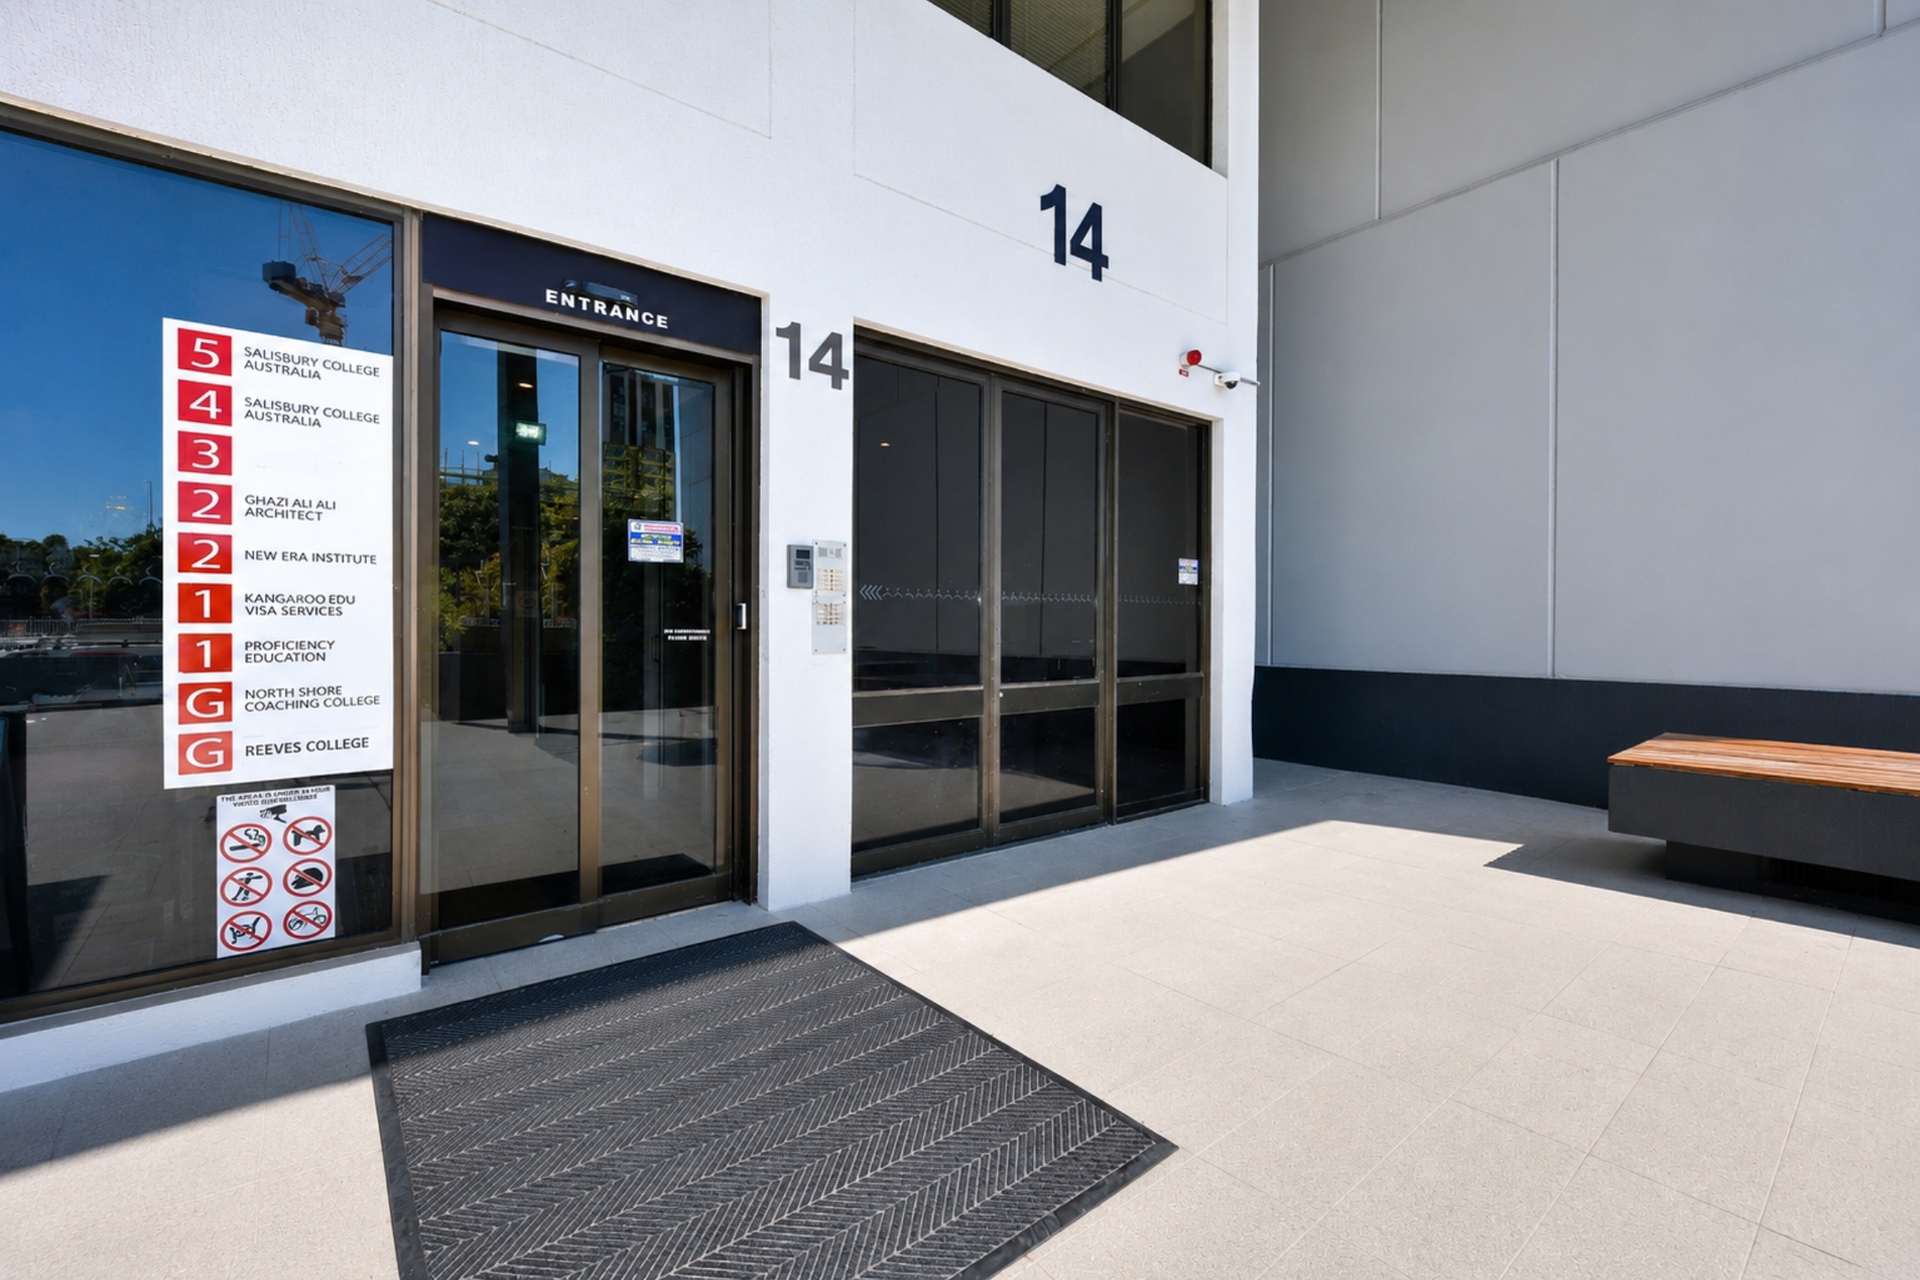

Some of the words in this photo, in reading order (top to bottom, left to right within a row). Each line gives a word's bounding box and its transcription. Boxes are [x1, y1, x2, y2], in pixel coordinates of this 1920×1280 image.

[1041, 184, 1108, 282] 14
[546, 289, 667, 328] ENTRANCE
[191, 337, 220, 369] 5
[245, 347, 318, 366] SALISBURY
[323, 360, 379, 377] COLLEGE
[776, 322, 849, 390] 14
[244, 360, 321, 380] AUSTRALIA
[190, 391, 221, 419] 4
[245, 397, 319, 415] SALISBURY
[323, 408, 379, 424] COLLEGE
[245, 410, 321, 427] AUSTRALIA
[192, 440, 219, 468] 3
[192, 490, 220, 518] 2
[245, 495, 288, 507] GHAZI
[292, 499, 313, 510] ALI
[316, 500, 336, 510] ALI
[245, 507, 322, 520] ARCHITECT
[192, 540, 220, 568] 2
[245, 550, 277, 560] NEW
[282, 552, 308, 561] ERA
[312, 553, 376, 564] INSTITUTE
[196, 590, 210, 617] 1
[245, 594, 326, 605] KANGAROO
[329, 594, 356, 605] EDU
[245, 606, 277, 615] VISA
[281, 606, 343, 616] SERVICES
[197, 640, 210, 667] 1
[245, 640, 335, 651] PROFICIENCY
[245, 652, 326, 663] EDUCATION
[186, 688, 224, 718] G
[245, 688, 294, 699] NORTH
[299, 686, 342, 697] SHORE
[245, 699, 319, 712] COACHING
[323, 696, 380, 707] COLLEGE
[186, 738, 224, 768] G
[246, 742, 301, 756] REEVES
[306, 737, 369, 752] COLLEGE
